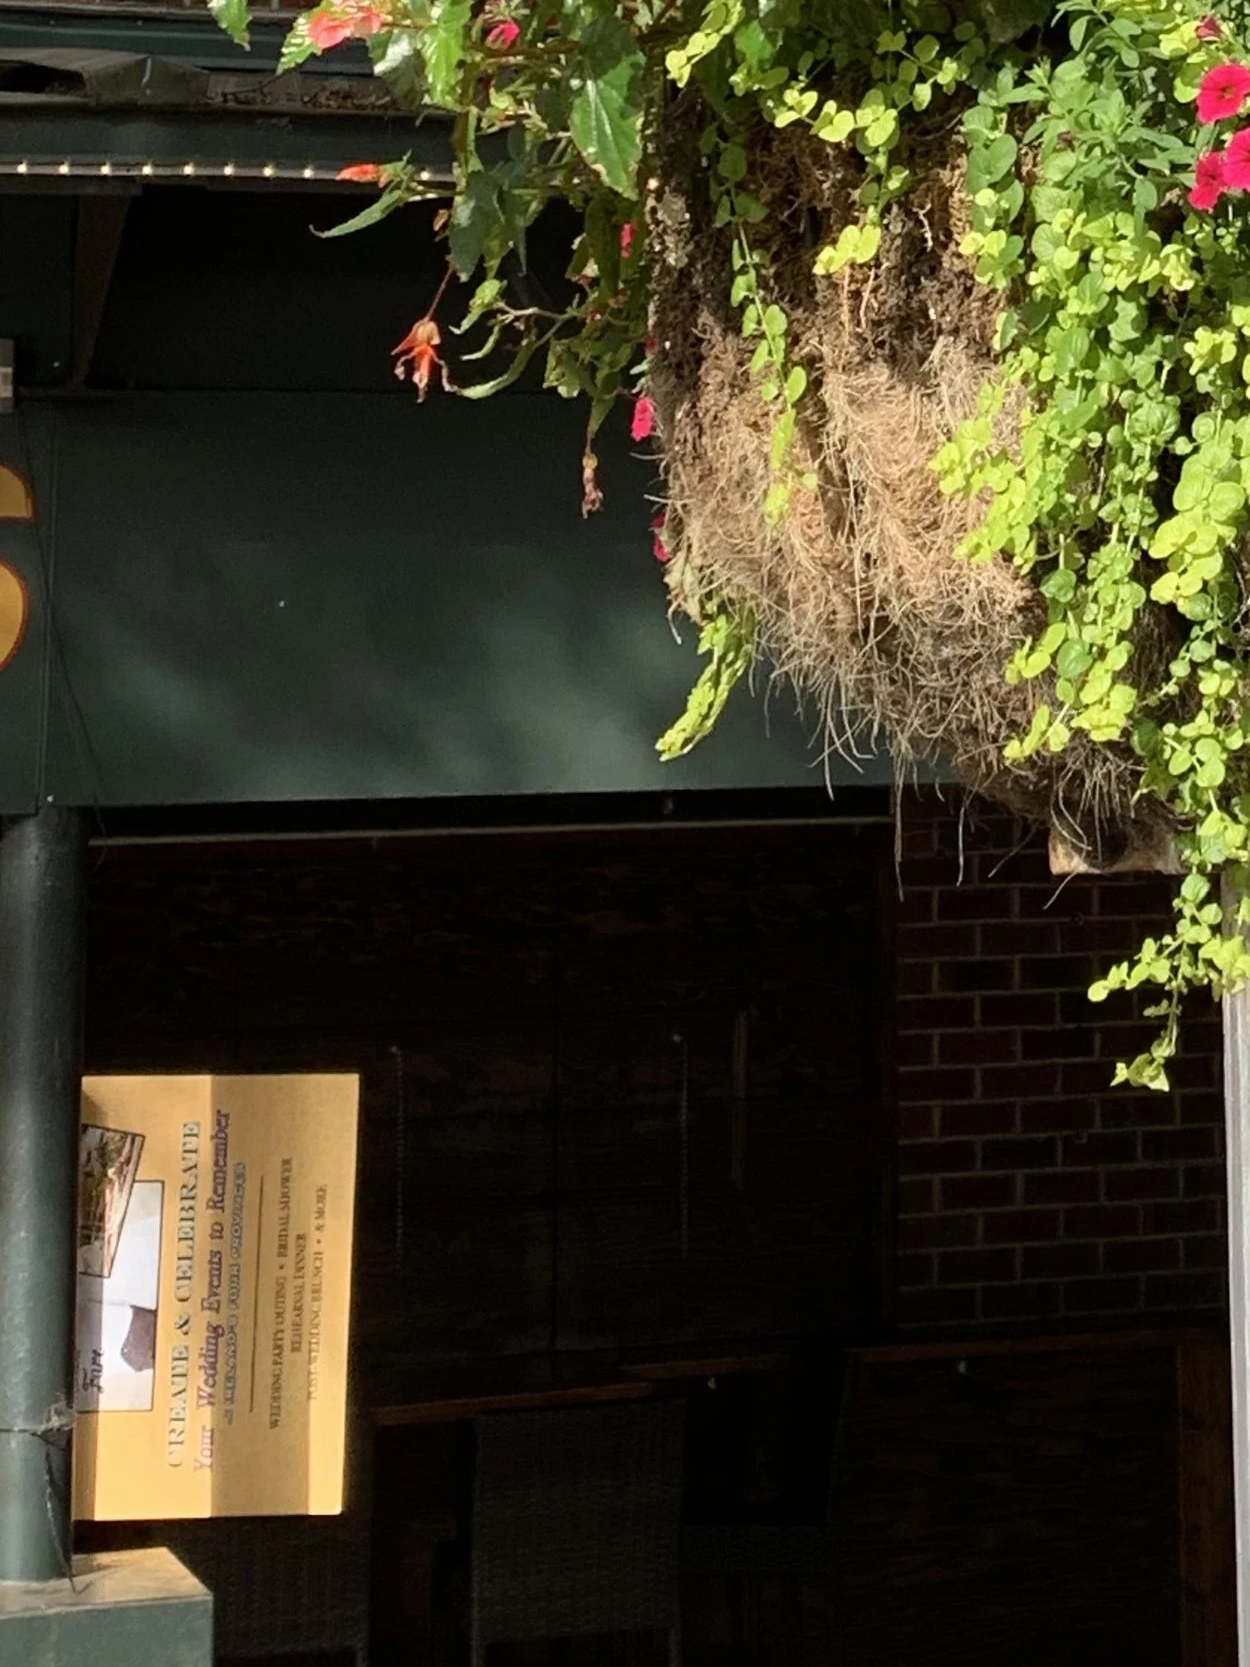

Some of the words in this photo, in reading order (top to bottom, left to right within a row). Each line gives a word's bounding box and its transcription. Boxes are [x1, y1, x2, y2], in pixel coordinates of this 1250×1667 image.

[206, 1110, 230, 1213] Remember
[280, 1158, 292, 1212] SHOWER
[174, 1121, 200, 1302] CELEBRATE
[207, 1222, 223, 1240] to
[277, 1213, 290, 1258] BRIDAL
[200, 1250, 222, 1314] Events
[294, 1233, 306, 1279] DINNER
[175, 1312, 191, 1335] &
[274, 1277, 287, 1324] OUTING
[291, 1280, 305, 1353] REHEARSAL
[196, 1322, 225, 1409] Wedding
[272, 1329, 285, 1366] PARTY
[168, 1346, 188, 1468] CREATE
[269, 1367, 282, 1430] WEDDING
[193, 1425, 214, 1472] Your
